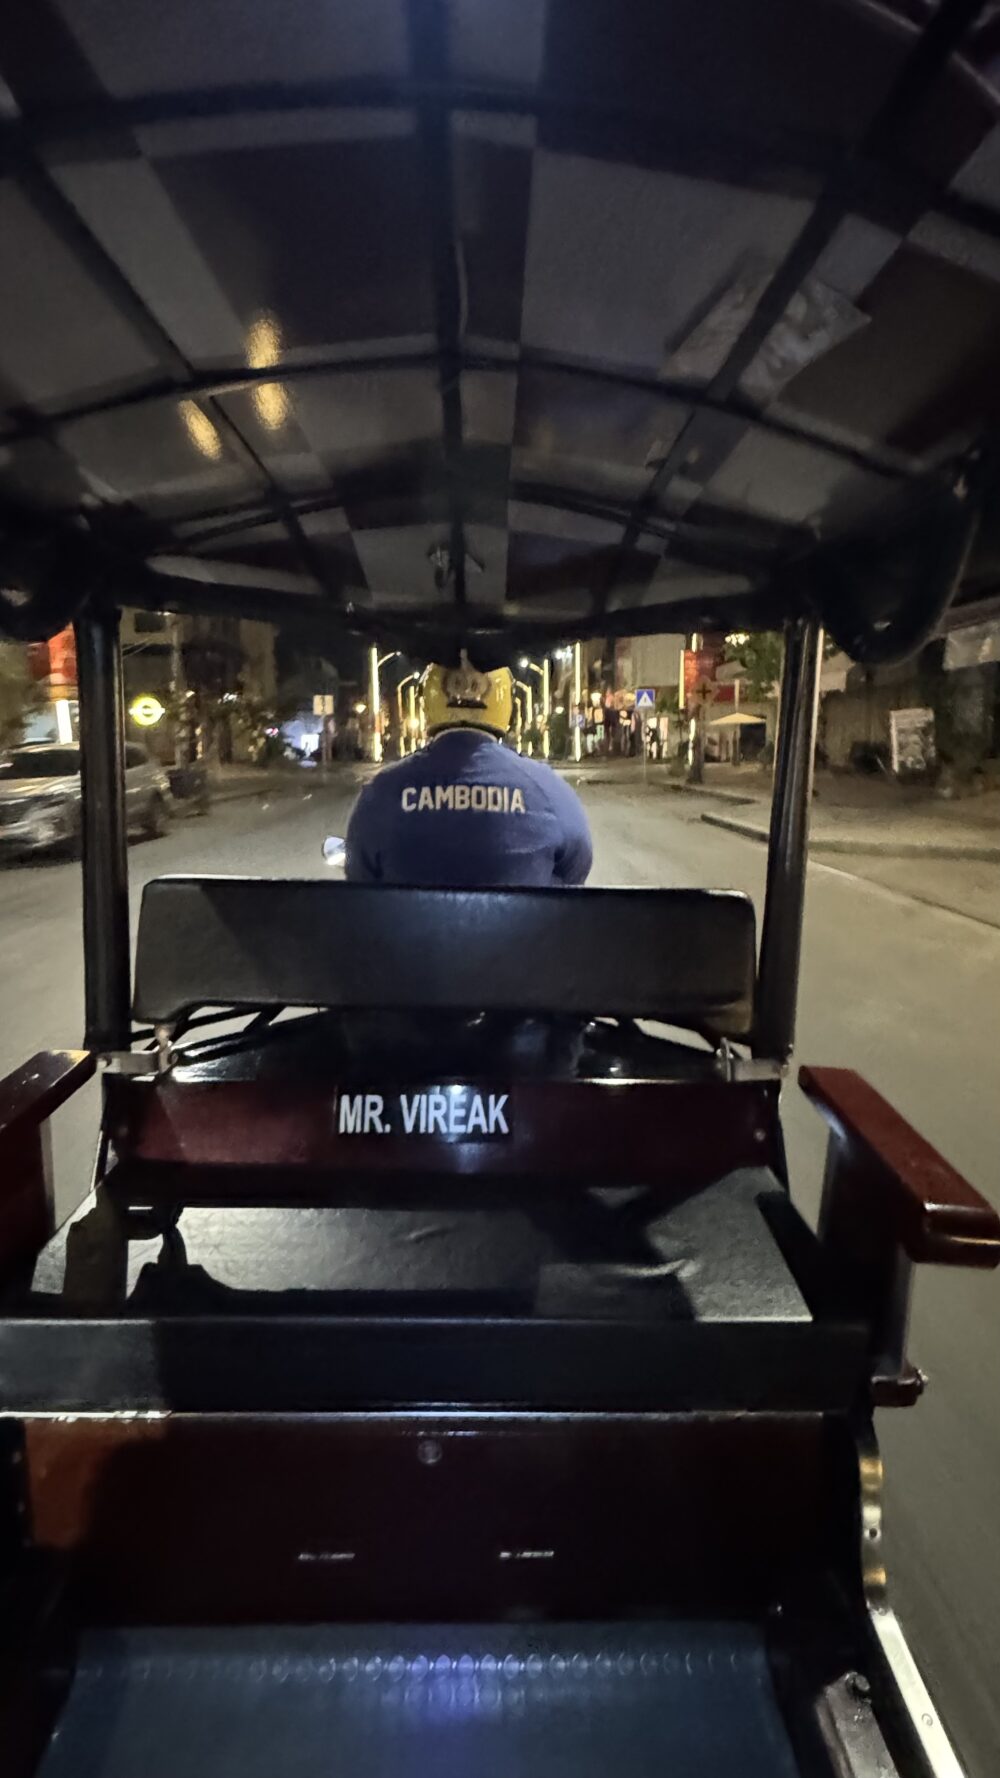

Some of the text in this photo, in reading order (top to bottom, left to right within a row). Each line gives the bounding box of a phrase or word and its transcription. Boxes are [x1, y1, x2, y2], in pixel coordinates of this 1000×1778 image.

[401, 785, 526, 814] CAMBODIA
[339, 1093, 509, 1134] MR. VIREAK
